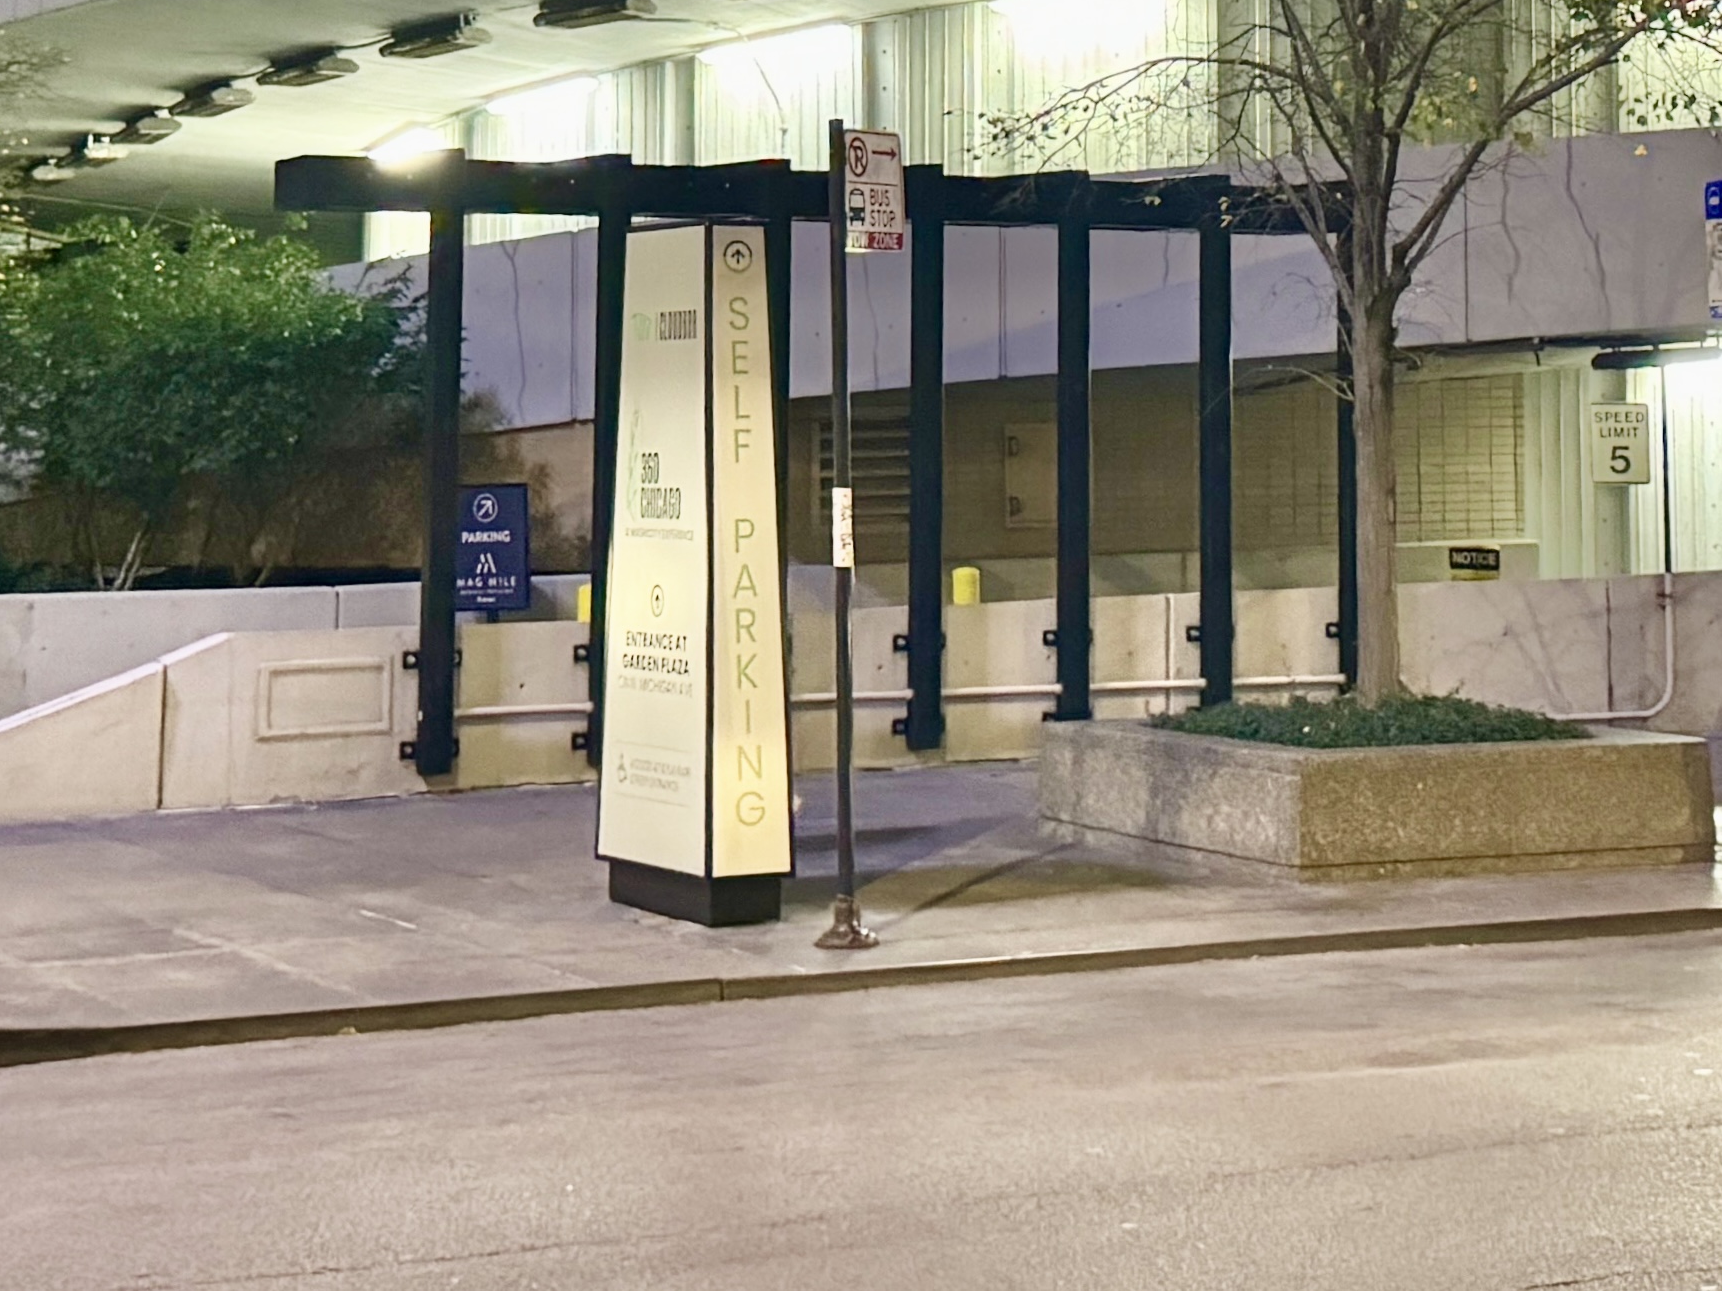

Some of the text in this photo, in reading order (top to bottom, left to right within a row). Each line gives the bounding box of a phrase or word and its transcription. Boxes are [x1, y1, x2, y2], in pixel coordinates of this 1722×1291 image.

[870, 189, 890, 206] BUS
[870, 210, 895, 228] STOP
[873, 233, 899, 248] ZONE
[1593, 411, 1645, 424] SPEED
[1599, 426, 1640, 439] LIMIT
[1609, 445, 1632, 475] 5
[461, 530, 510, 543] PARKING
[728, 295, 767, 828] SELF PARKING
[1452, 550, 1498, 567] NOTICE
